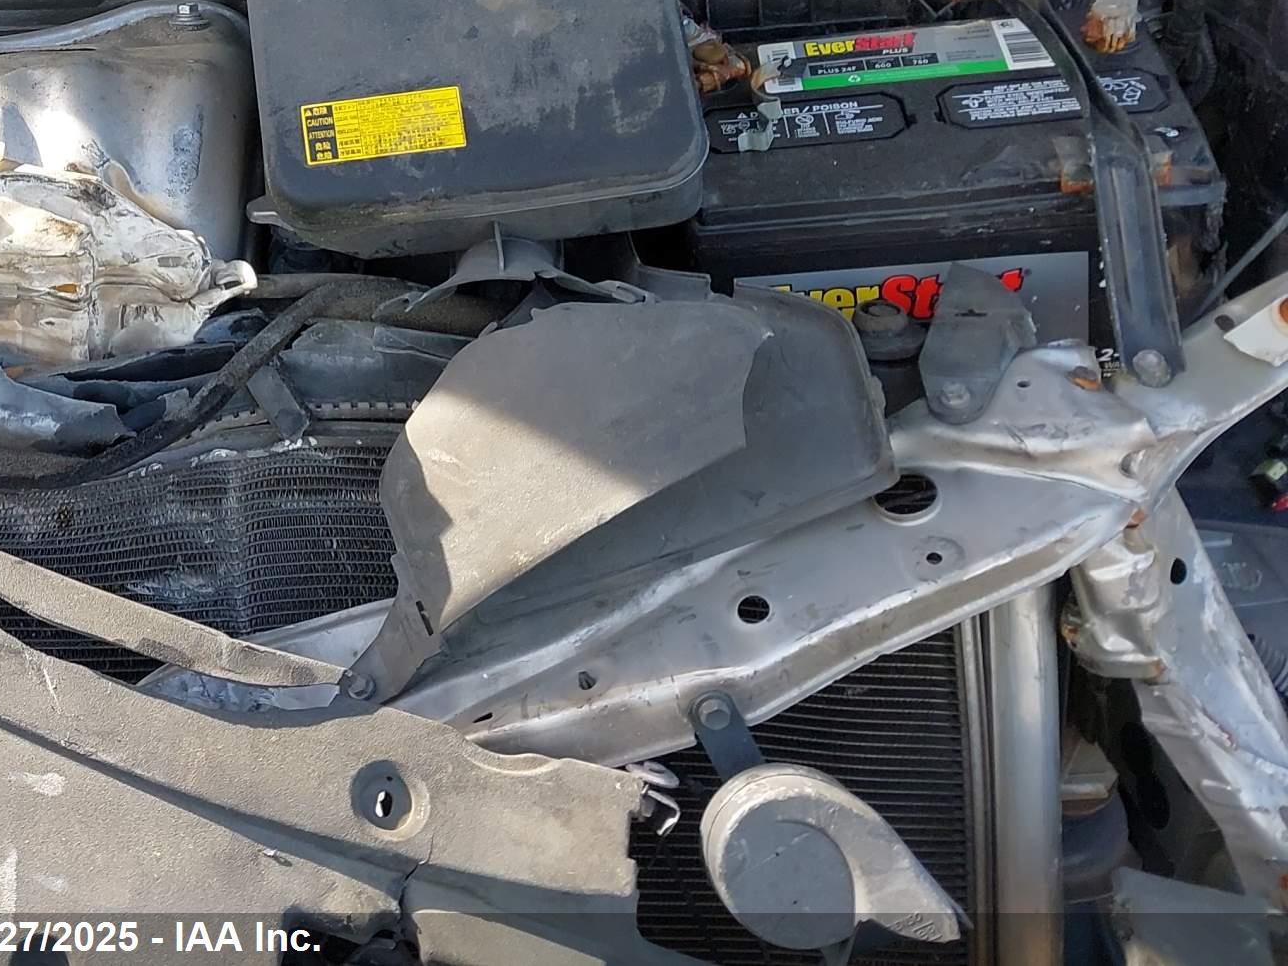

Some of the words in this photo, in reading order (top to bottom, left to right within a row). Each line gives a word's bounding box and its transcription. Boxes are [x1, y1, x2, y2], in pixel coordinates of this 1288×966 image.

[804, 32, 915, 57] EverStart
[882, 47, 909, 55] PLUS
[817, 67, 840, 75] PLUS
[750, 107, 800, 119] DER
[812, 101, 858, 112] POISON
[306, 116, 334, 128] CAUTION
[308, 129, 335, 140] ATTENTION
